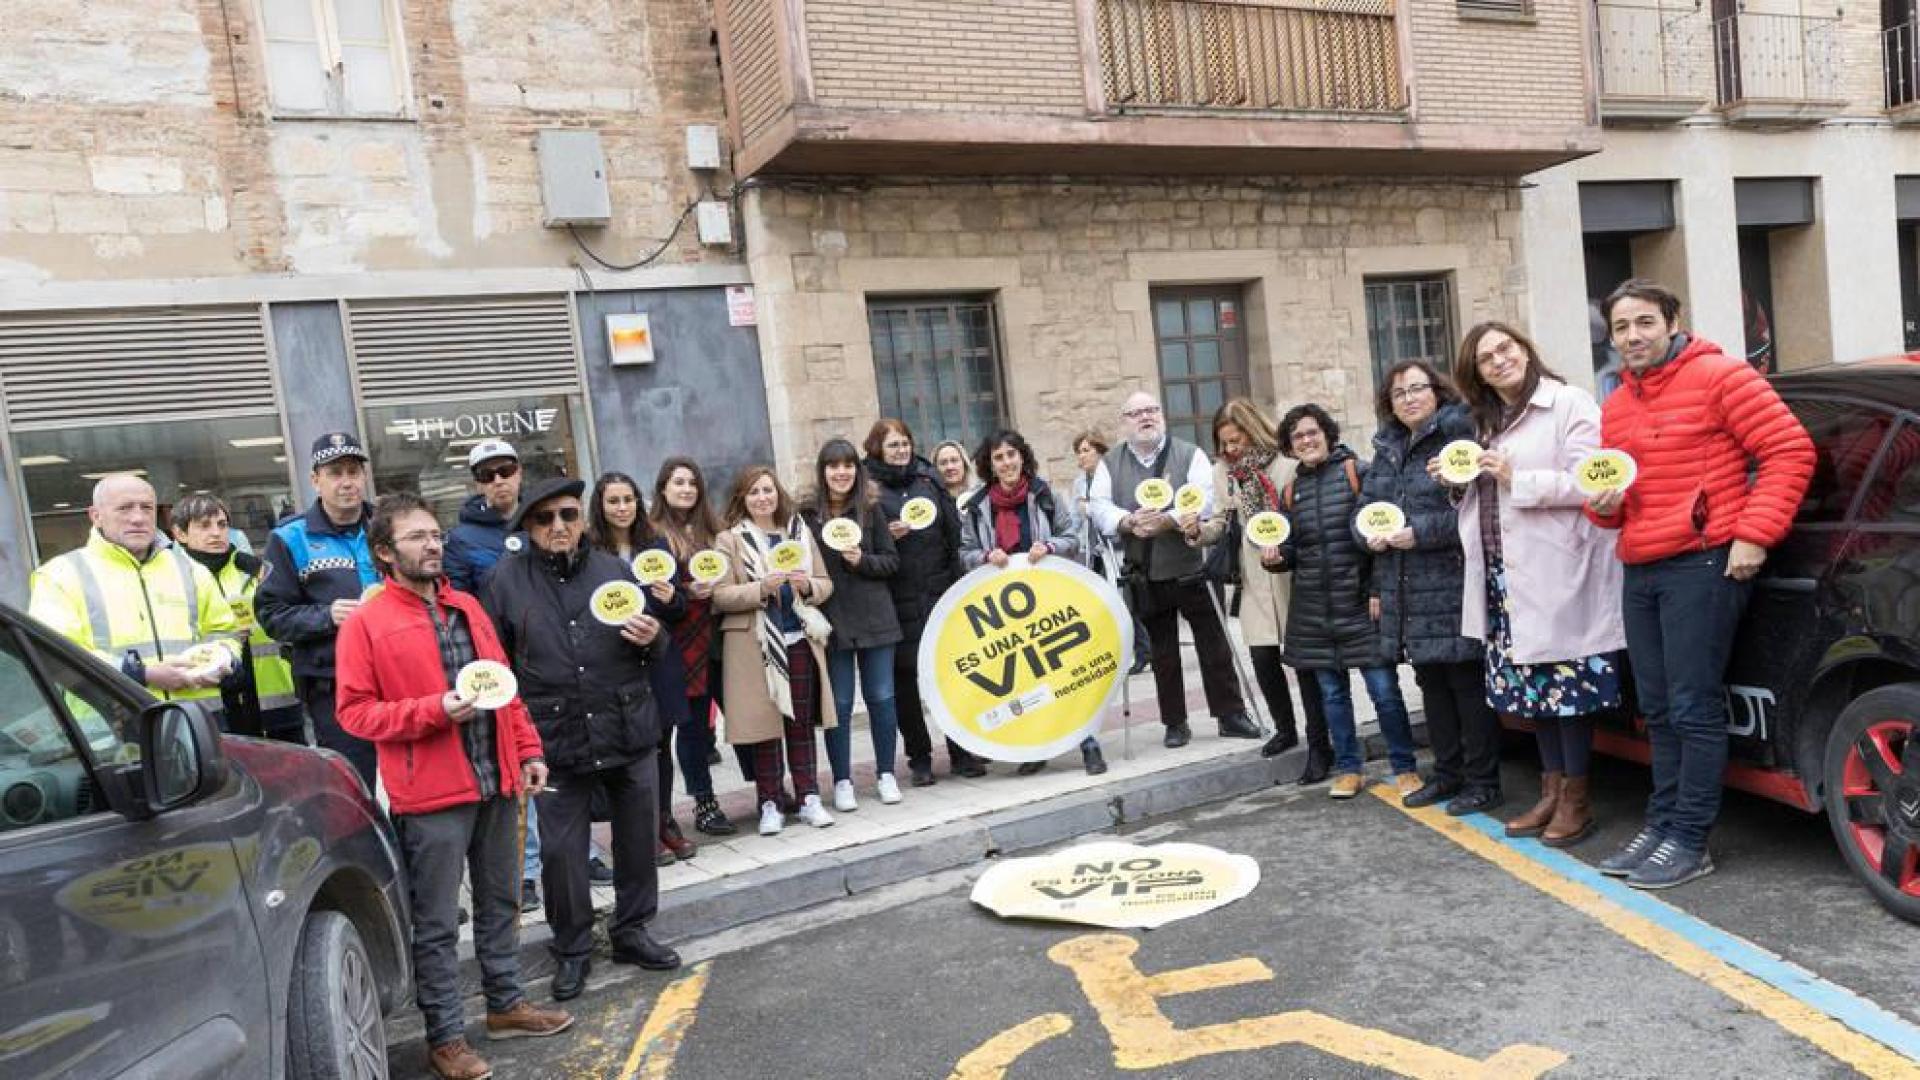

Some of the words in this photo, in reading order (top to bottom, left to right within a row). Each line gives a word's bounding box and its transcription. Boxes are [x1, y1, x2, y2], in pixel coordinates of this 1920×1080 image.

[964, 582, 1037, 639] NO
[955, 652, 981, 674] ES
[983, 633, 1025, 660] UNA
[1025, 604, 1081, 639] ZONA
[965, 621, 1092, 698] VIP
[1071, 665, 1087, 678] es
[1089, 651, 1113, 668] una
[1054, 660, 1118, 699] necesidad
[1074, 858, 1162, 876] NO
[1035, 875, 1204, 899] VIP
